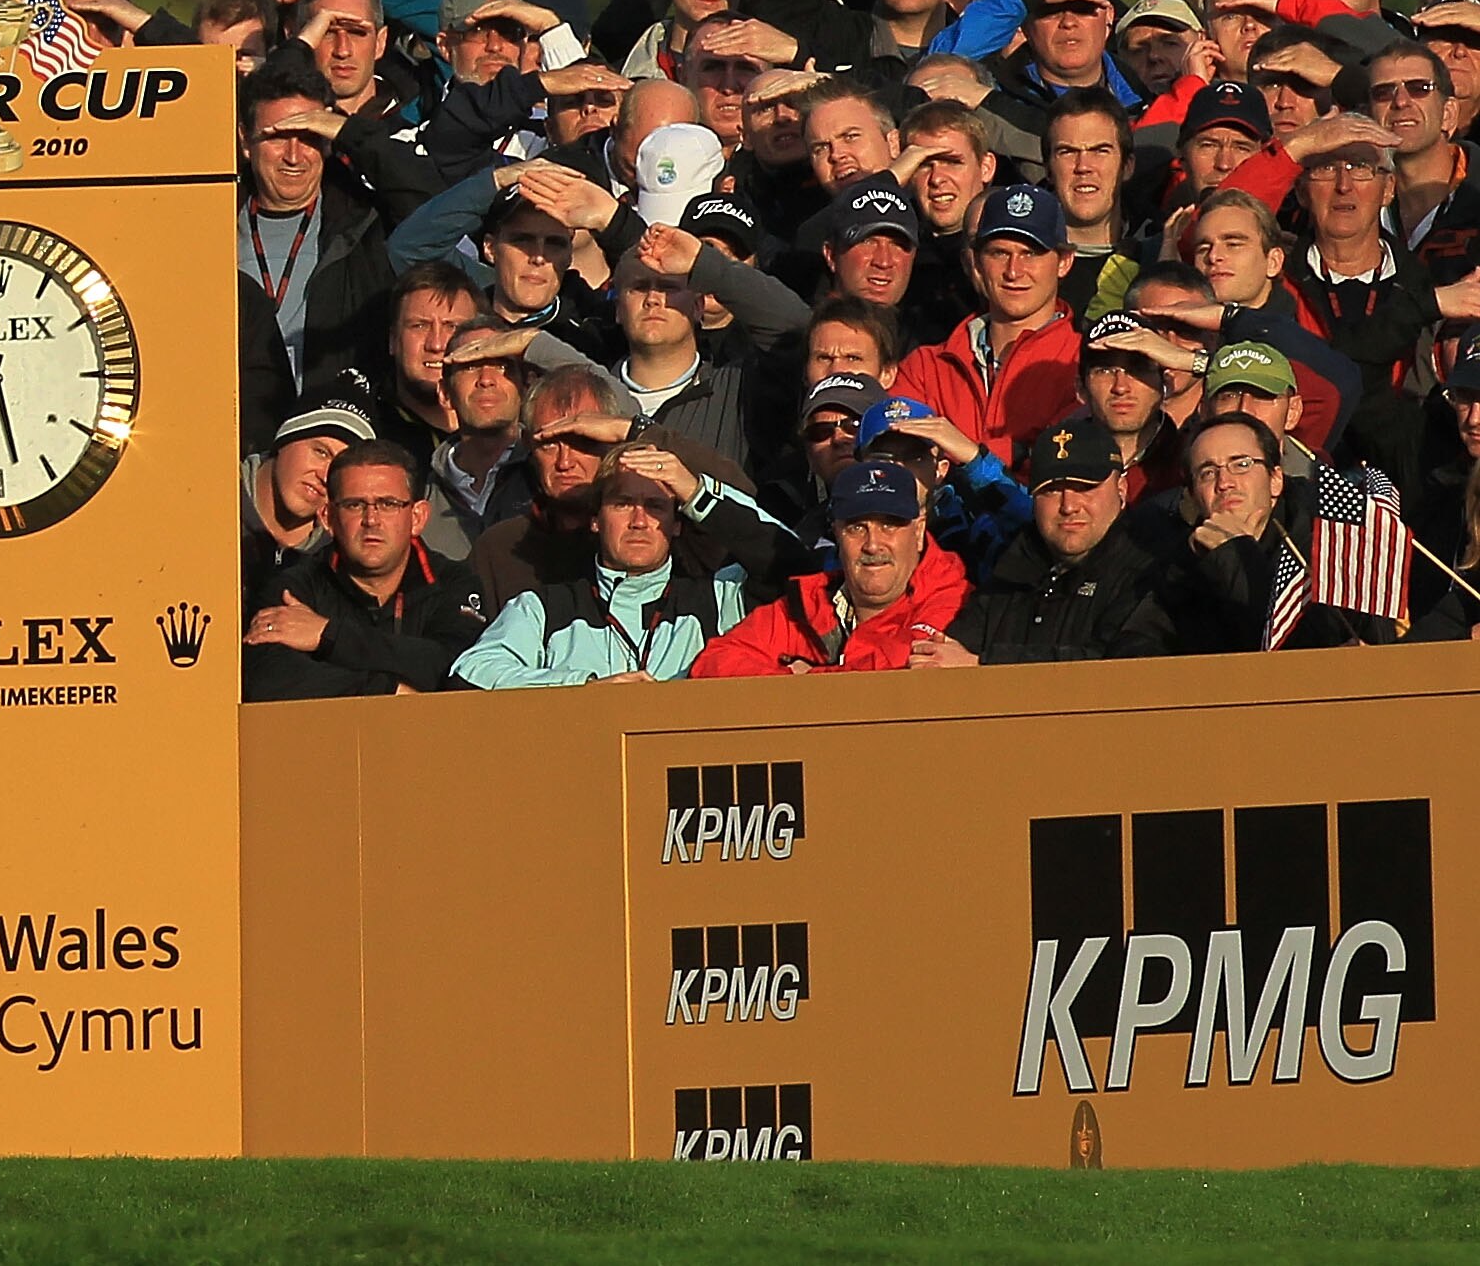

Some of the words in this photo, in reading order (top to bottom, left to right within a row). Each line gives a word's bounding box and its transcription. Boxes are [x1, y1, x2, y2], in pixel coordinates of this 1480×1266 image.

[38, 67, 188, 123] CUP
[31, 137, 88, 158] 2010
[692, 199, 755, 229] Titleist
[852, 190, 907, 211] Callaway
[661, 802, 796, 865] KPMG
[665, 964, 801, 1026] KPMG
[1012, 920, 1407, 1097] KPMG
[673, 1124, 804, 1162] KPMG
